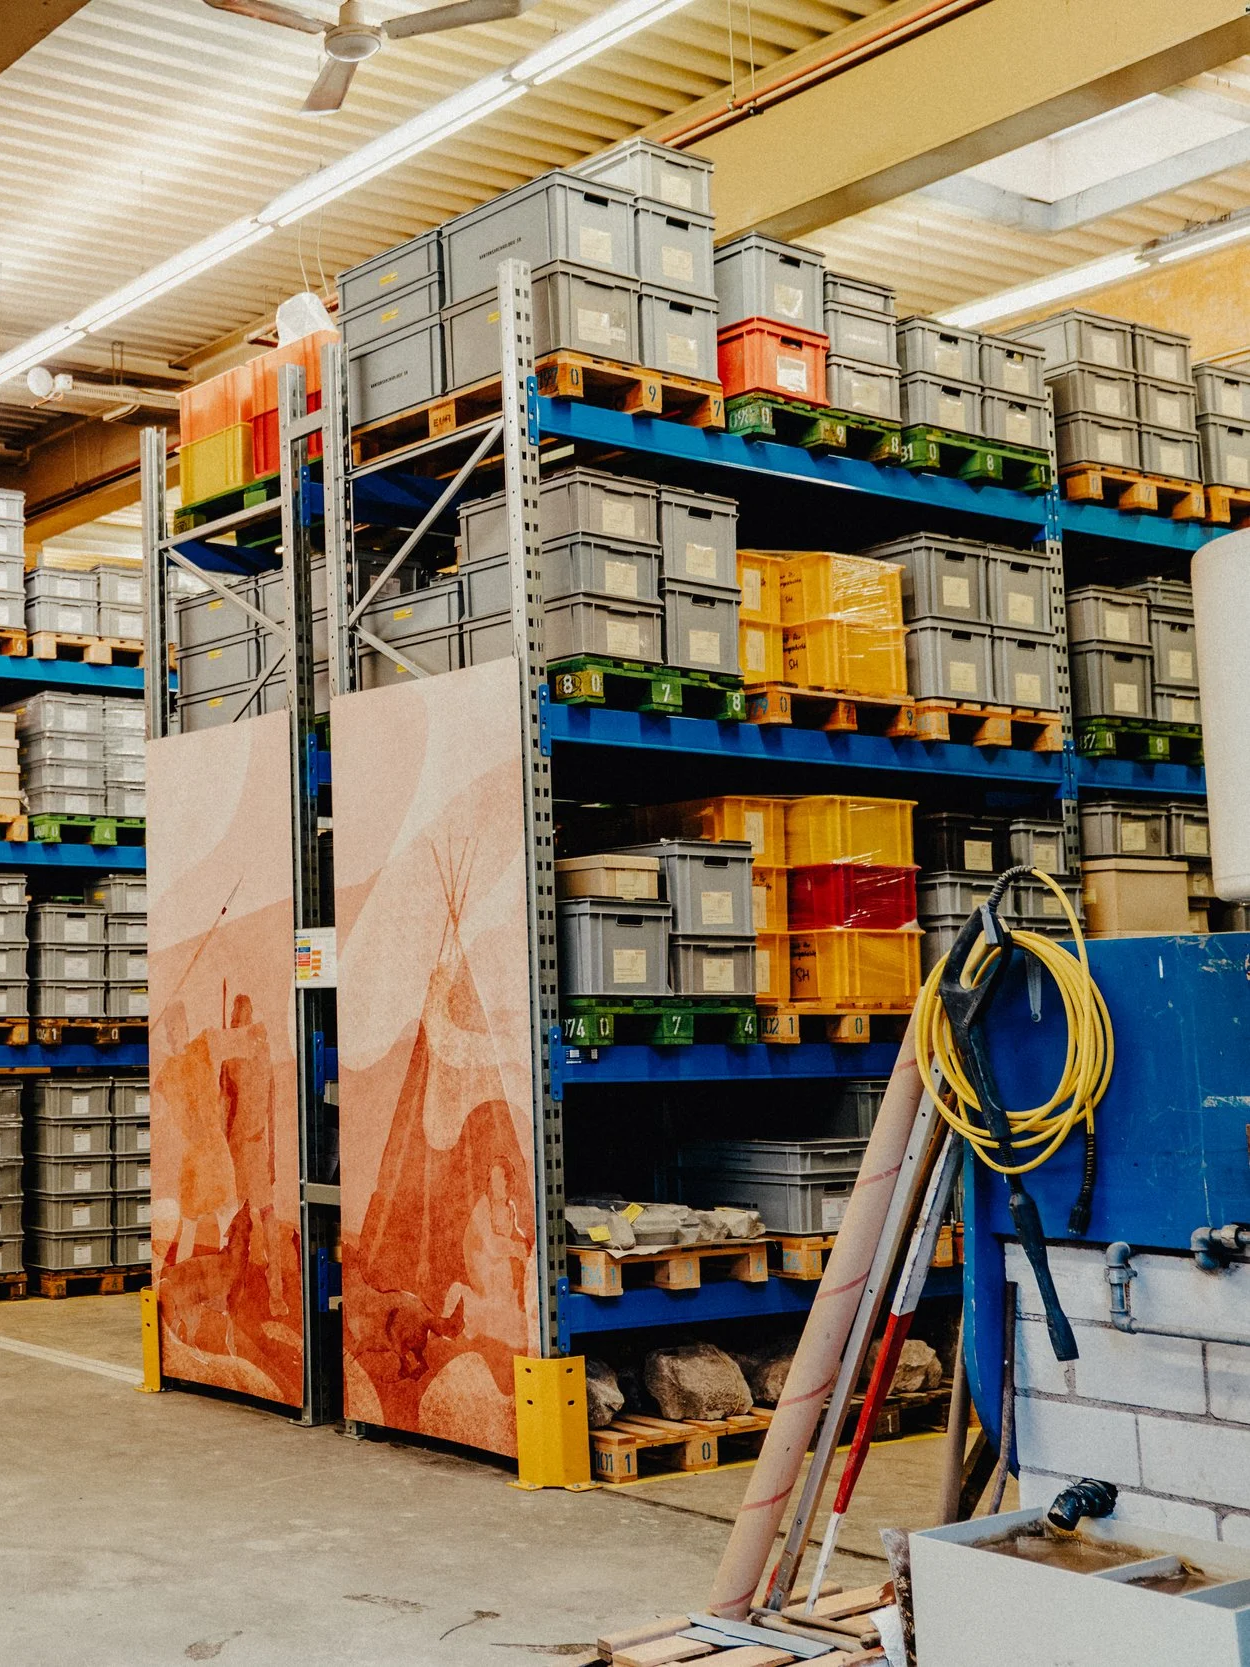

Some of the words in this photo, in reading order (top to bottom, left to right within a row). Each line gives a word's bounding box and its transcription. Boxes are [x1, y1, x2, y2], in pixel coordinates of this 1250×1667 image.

[570, 367, 579, 386] 0
[648, 385, 657, 402] 9
[713, 399, 721, 417] 7
[761, 406, 770, 424] 0
[836, 426, 844, 442] 9
[891, 436, 899, 453] 8
[929, 444, 937, 460] 0
[986, 454, 994, 471] 8
[1040, 466, 1046, 481] 1
[562, 672, 574, 694] 8
[591, 674, 600, 691] 0
[661, 683, 672, 703] 7
[732, 694, 741, 712] 8
[779, 696, 788, 713] 0
[906, 709, 914, 726] 9
[1156, 738, 1164, 753] 8
[795, 967, 810, 982] SH
[51, 1027, 57, 1040] 1
[599, 1017, 610, 1036] 0
[672, 1016, 680, 1035] 7
[744, 1016, 753, 1035] 4
[788, 1017, 795, 1034] 1
[854, 1017, 863, 1034] 0
[610, 1267, 616, 1287] 1
[886, 1413, 893, 1433] 1
[702, 1441, 711, 1461] 0
[625, 1453, 630, 1474] 1
